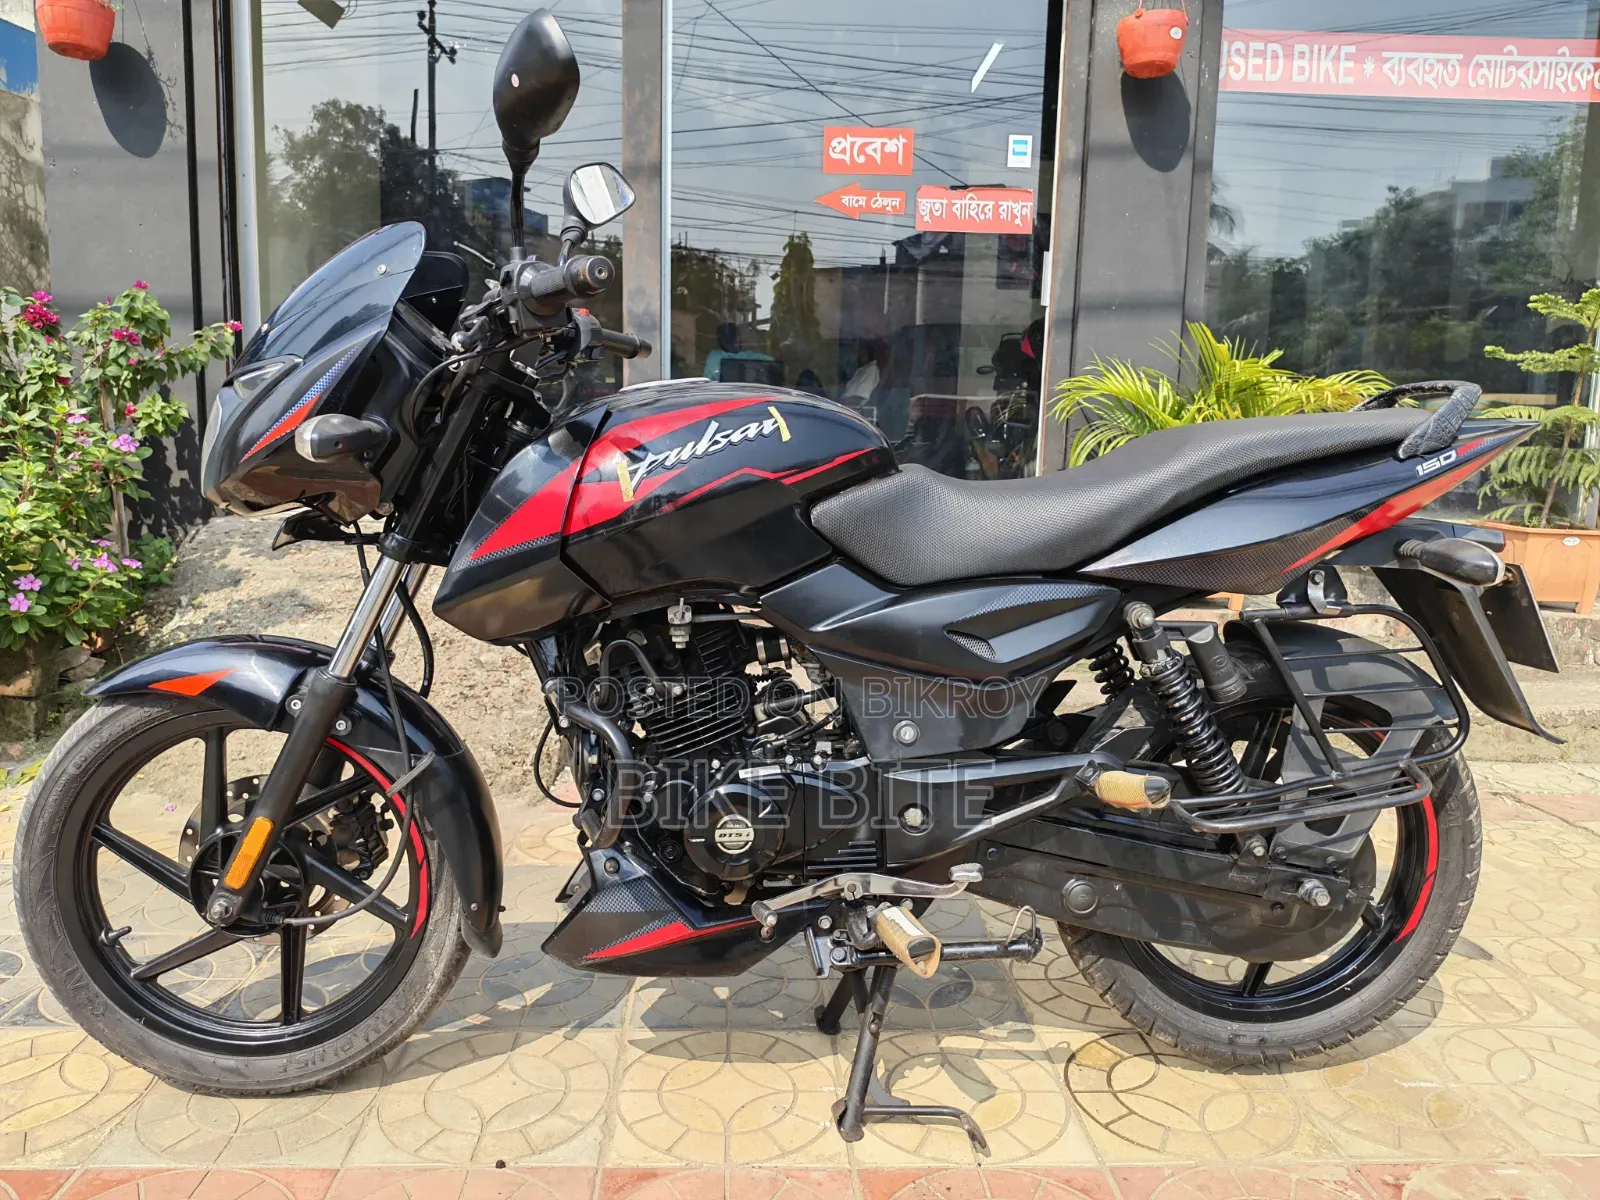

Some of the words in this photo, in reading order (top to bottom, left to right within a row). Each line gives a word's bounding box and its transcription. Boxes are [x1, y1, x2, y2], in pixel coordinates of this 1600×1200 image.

[1291, 43, 1357, 85] BIKE
[1382, 51, 1463, 90] ব্যবহৃত
[828, 133, 908, 166] প্রবেশ
[840, 193, 866, 208] বামে
[870, 192, 901, 212] ঠেলুন
[917, 197, 947, 224] জুতা
[951, 192, 994, 224] বাহিরে
[998, 198, 1034, 227] রাখুন
[1415, 449, 1457, 476] 150
